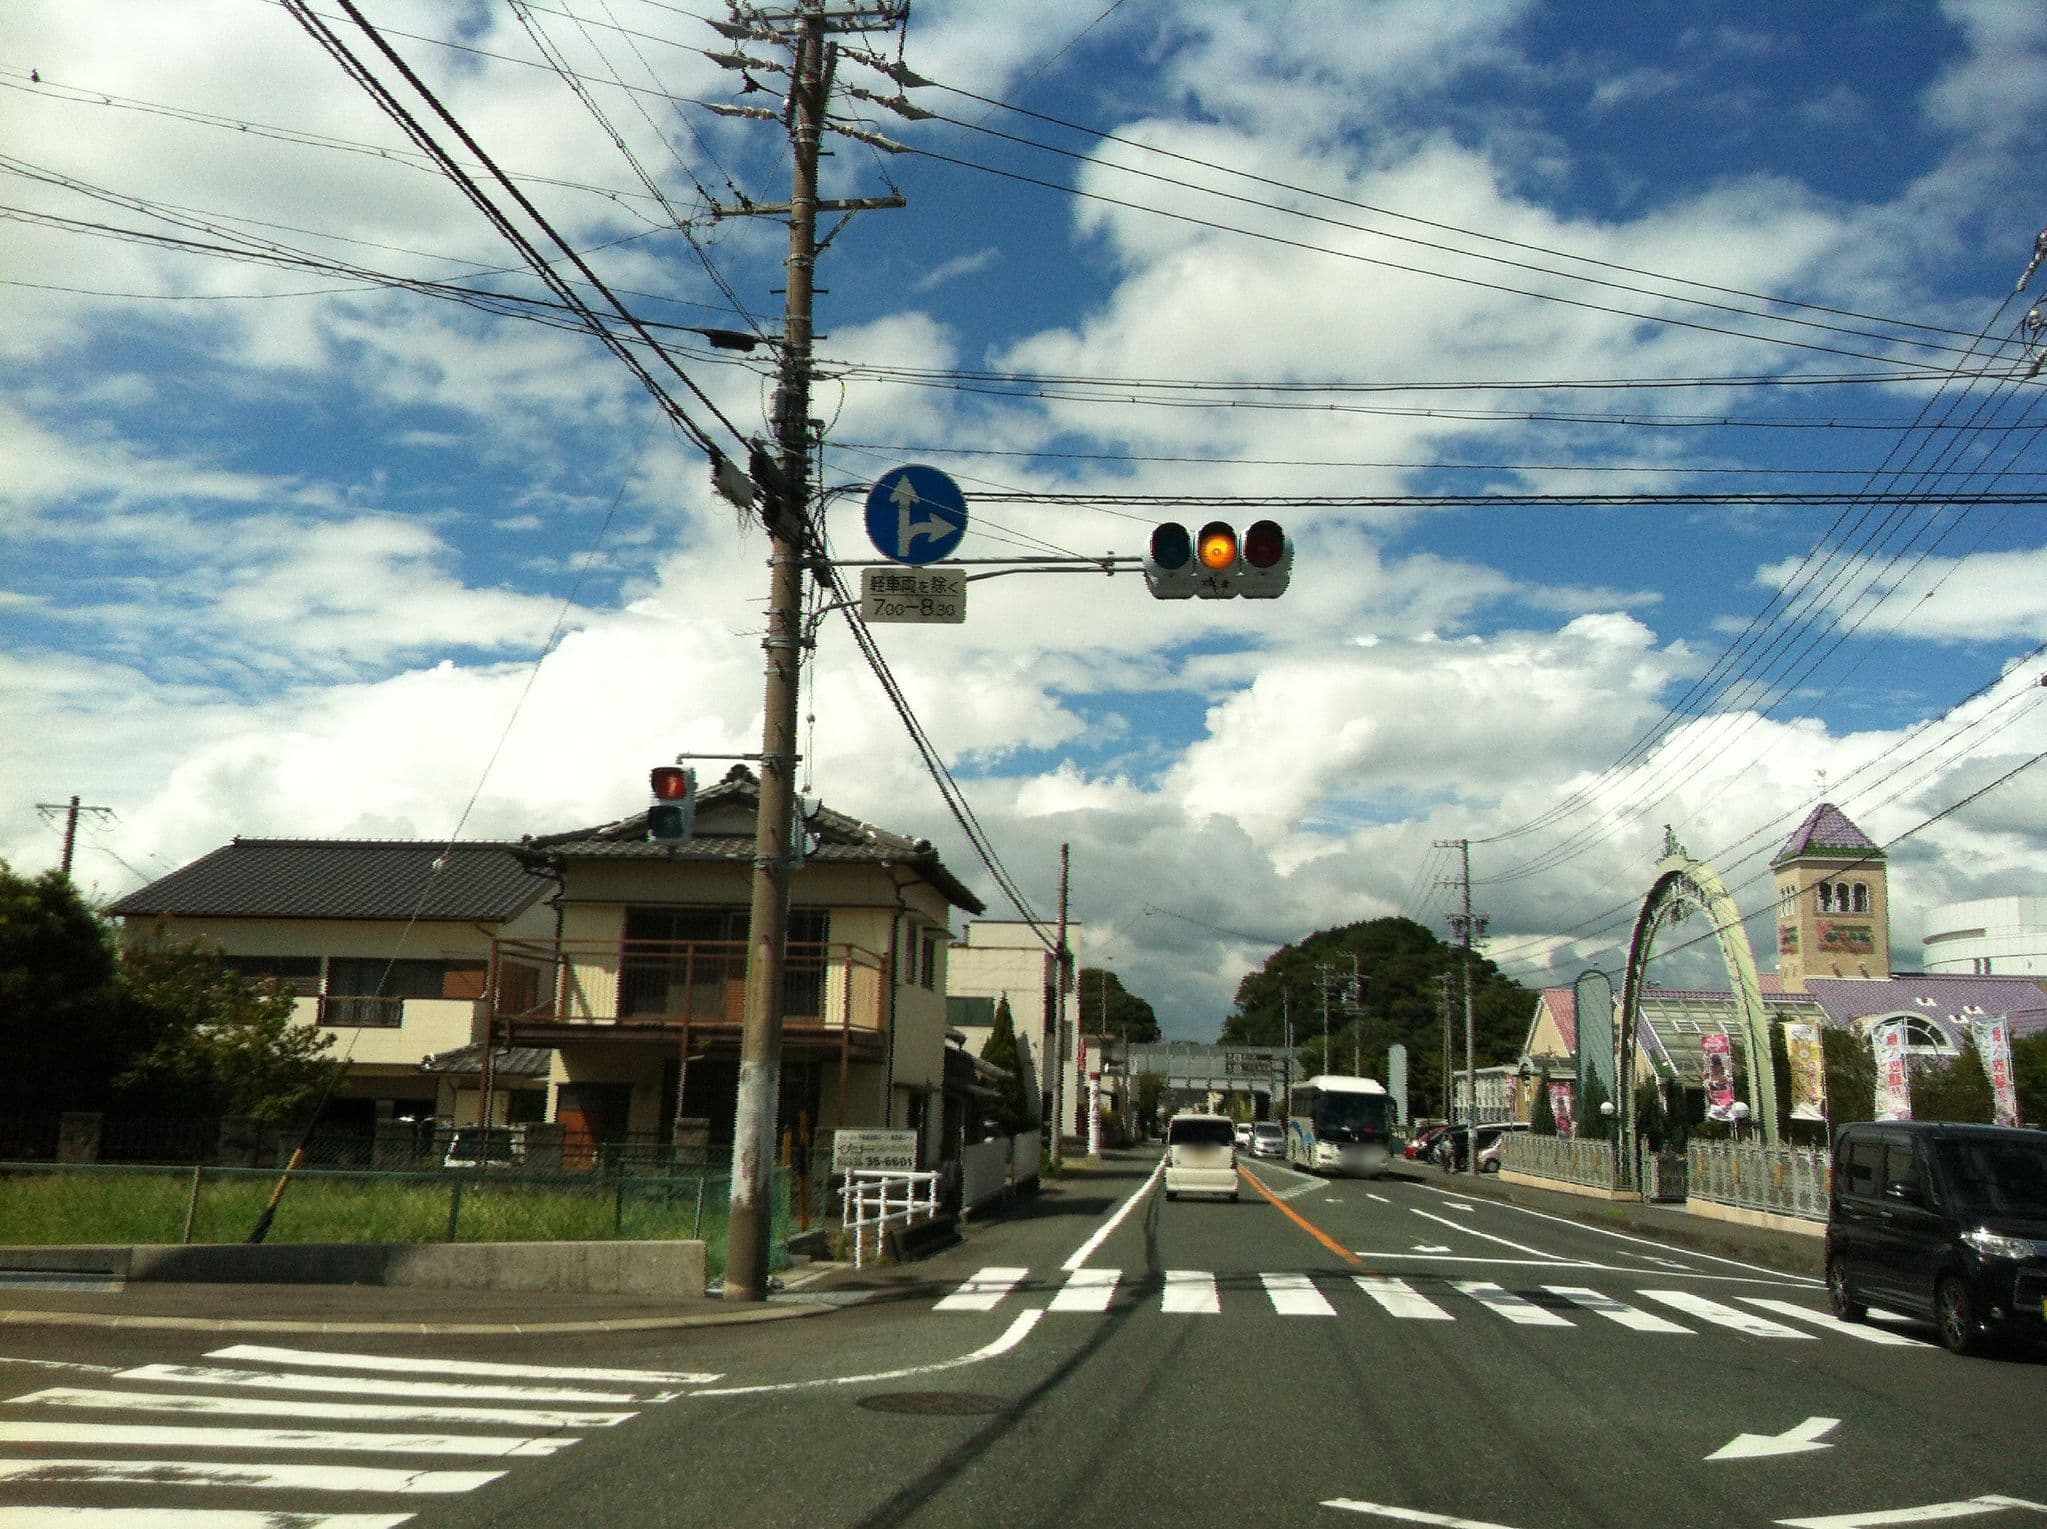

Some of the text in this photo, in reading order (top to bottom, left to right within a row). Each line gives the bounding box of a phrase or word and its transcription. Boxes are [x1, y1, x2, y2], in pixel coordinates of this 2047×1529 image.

[870, 575, 959, 594] 軽車両を除く
